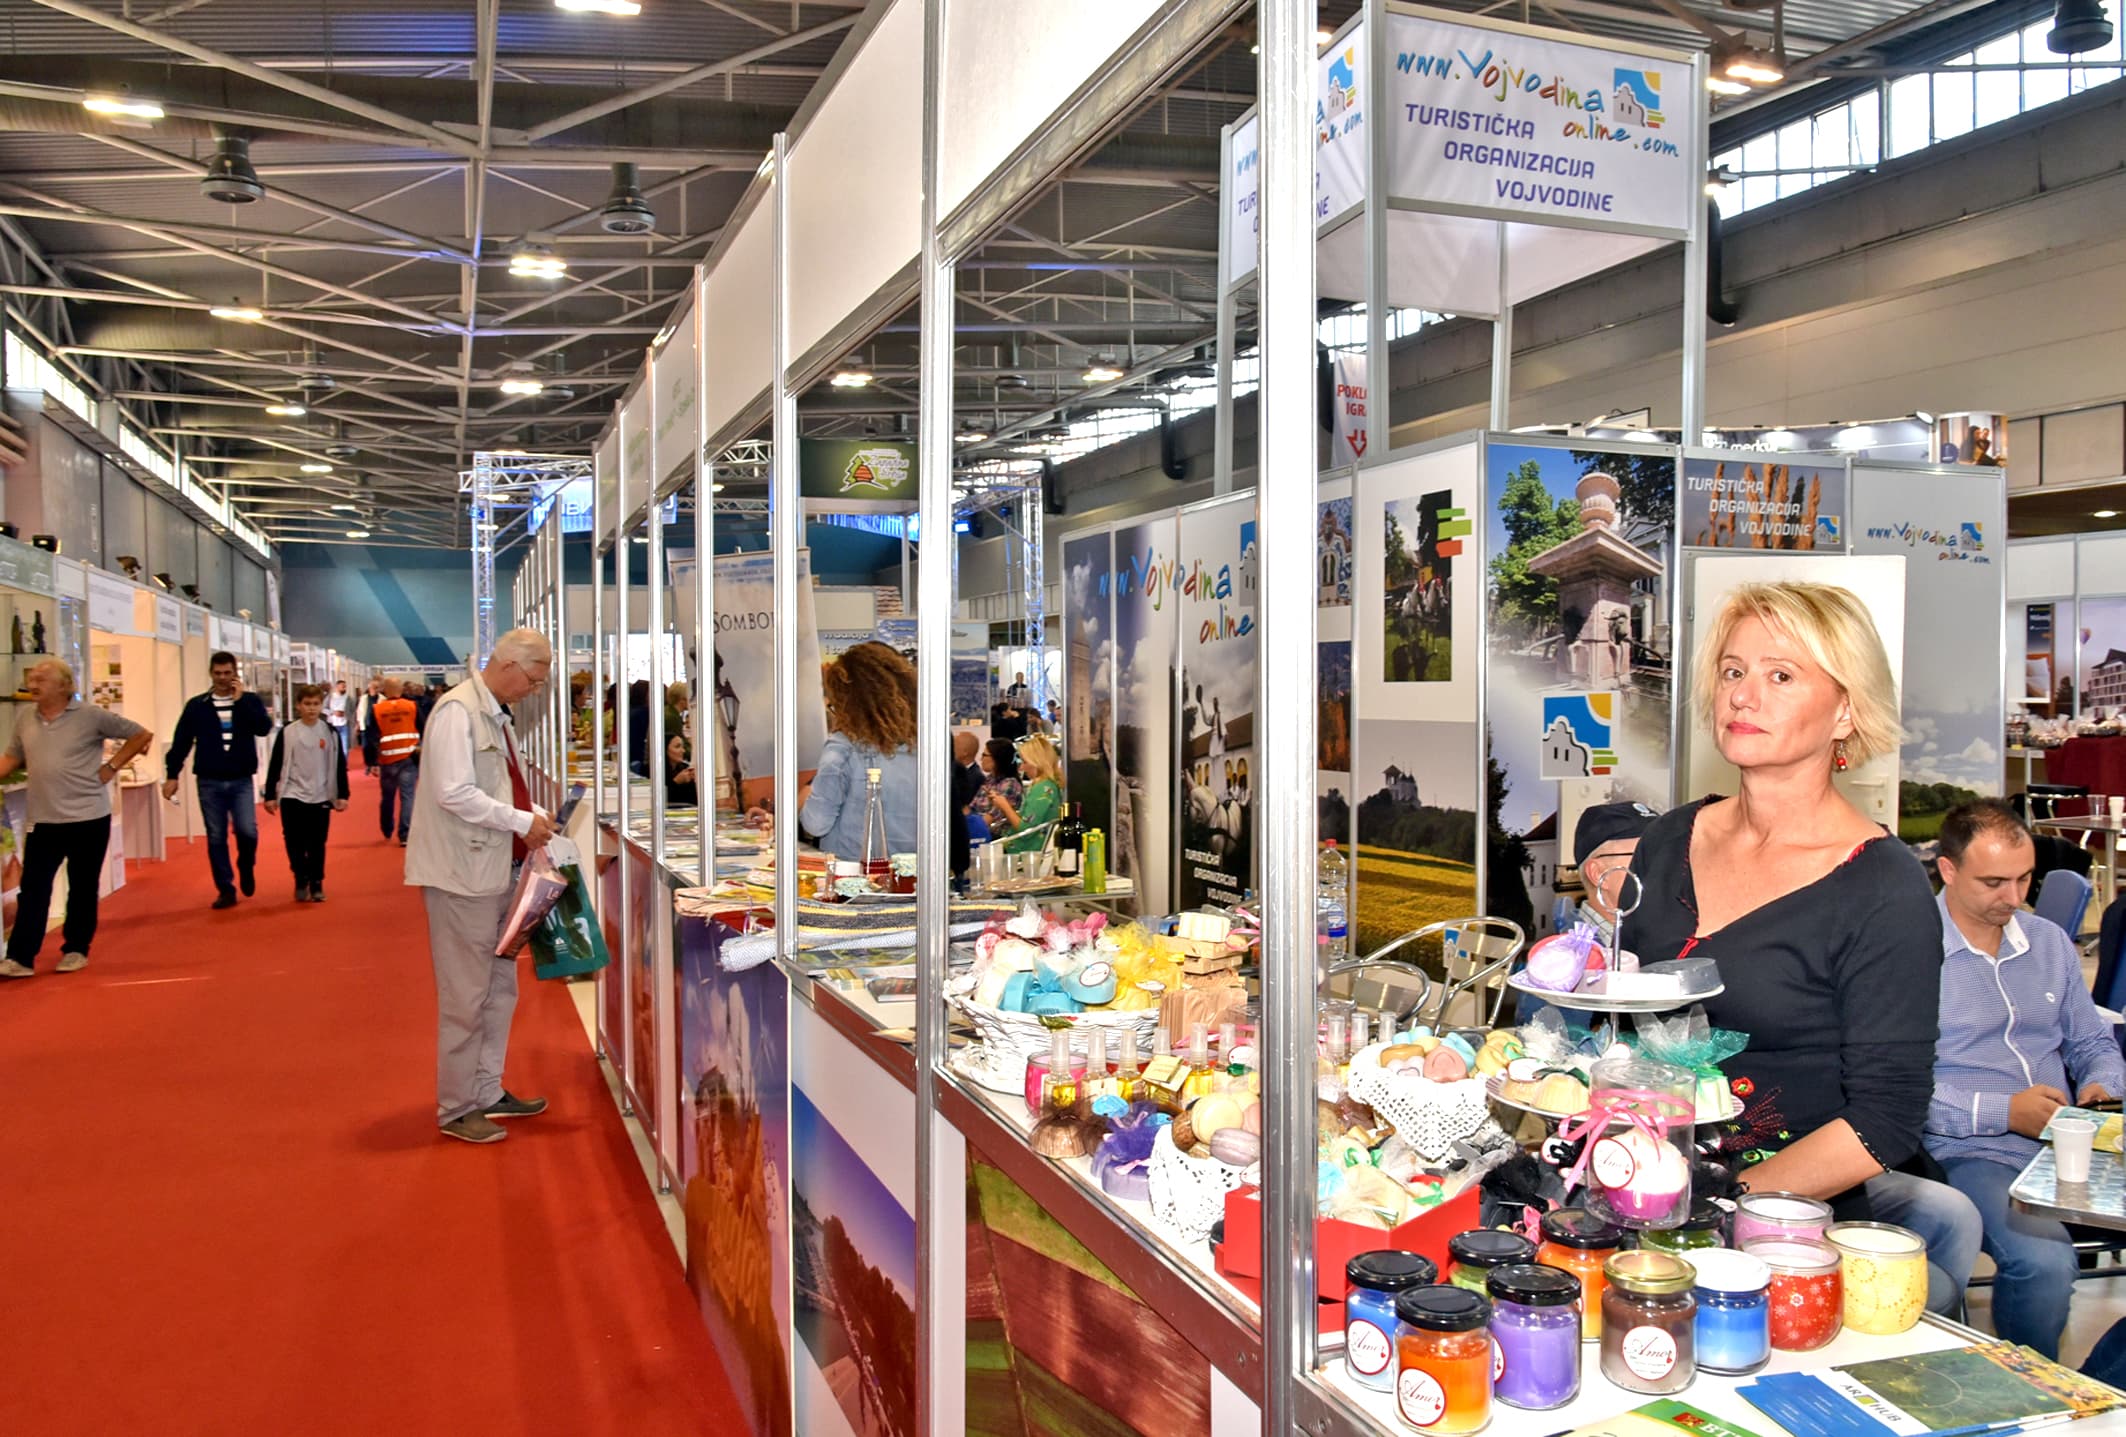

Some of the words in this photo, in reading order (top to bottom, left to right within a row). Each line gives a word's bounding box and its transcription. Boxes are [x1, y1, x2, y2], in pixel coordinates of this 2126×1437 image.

[1405, 103, 1536, 140] TURISTIČKA
[1443, 140, 1596, 180] ORGANIZACIJA
[1496, 178, 1614, 212] VOJVODINE
[1337, 384, 1367, 400] POKL
[1345, 402, 1367, 417] IGR
[1687, 476, 1765, 494] TURISTIČKA
[1709, 499, 1801, 516] ORGANIZACIJA
[1739, 520, 1813, 537] VOJVODINE
[713, 610, 776, 634] SOMBO
[1200, 603, 1255, 644] online
